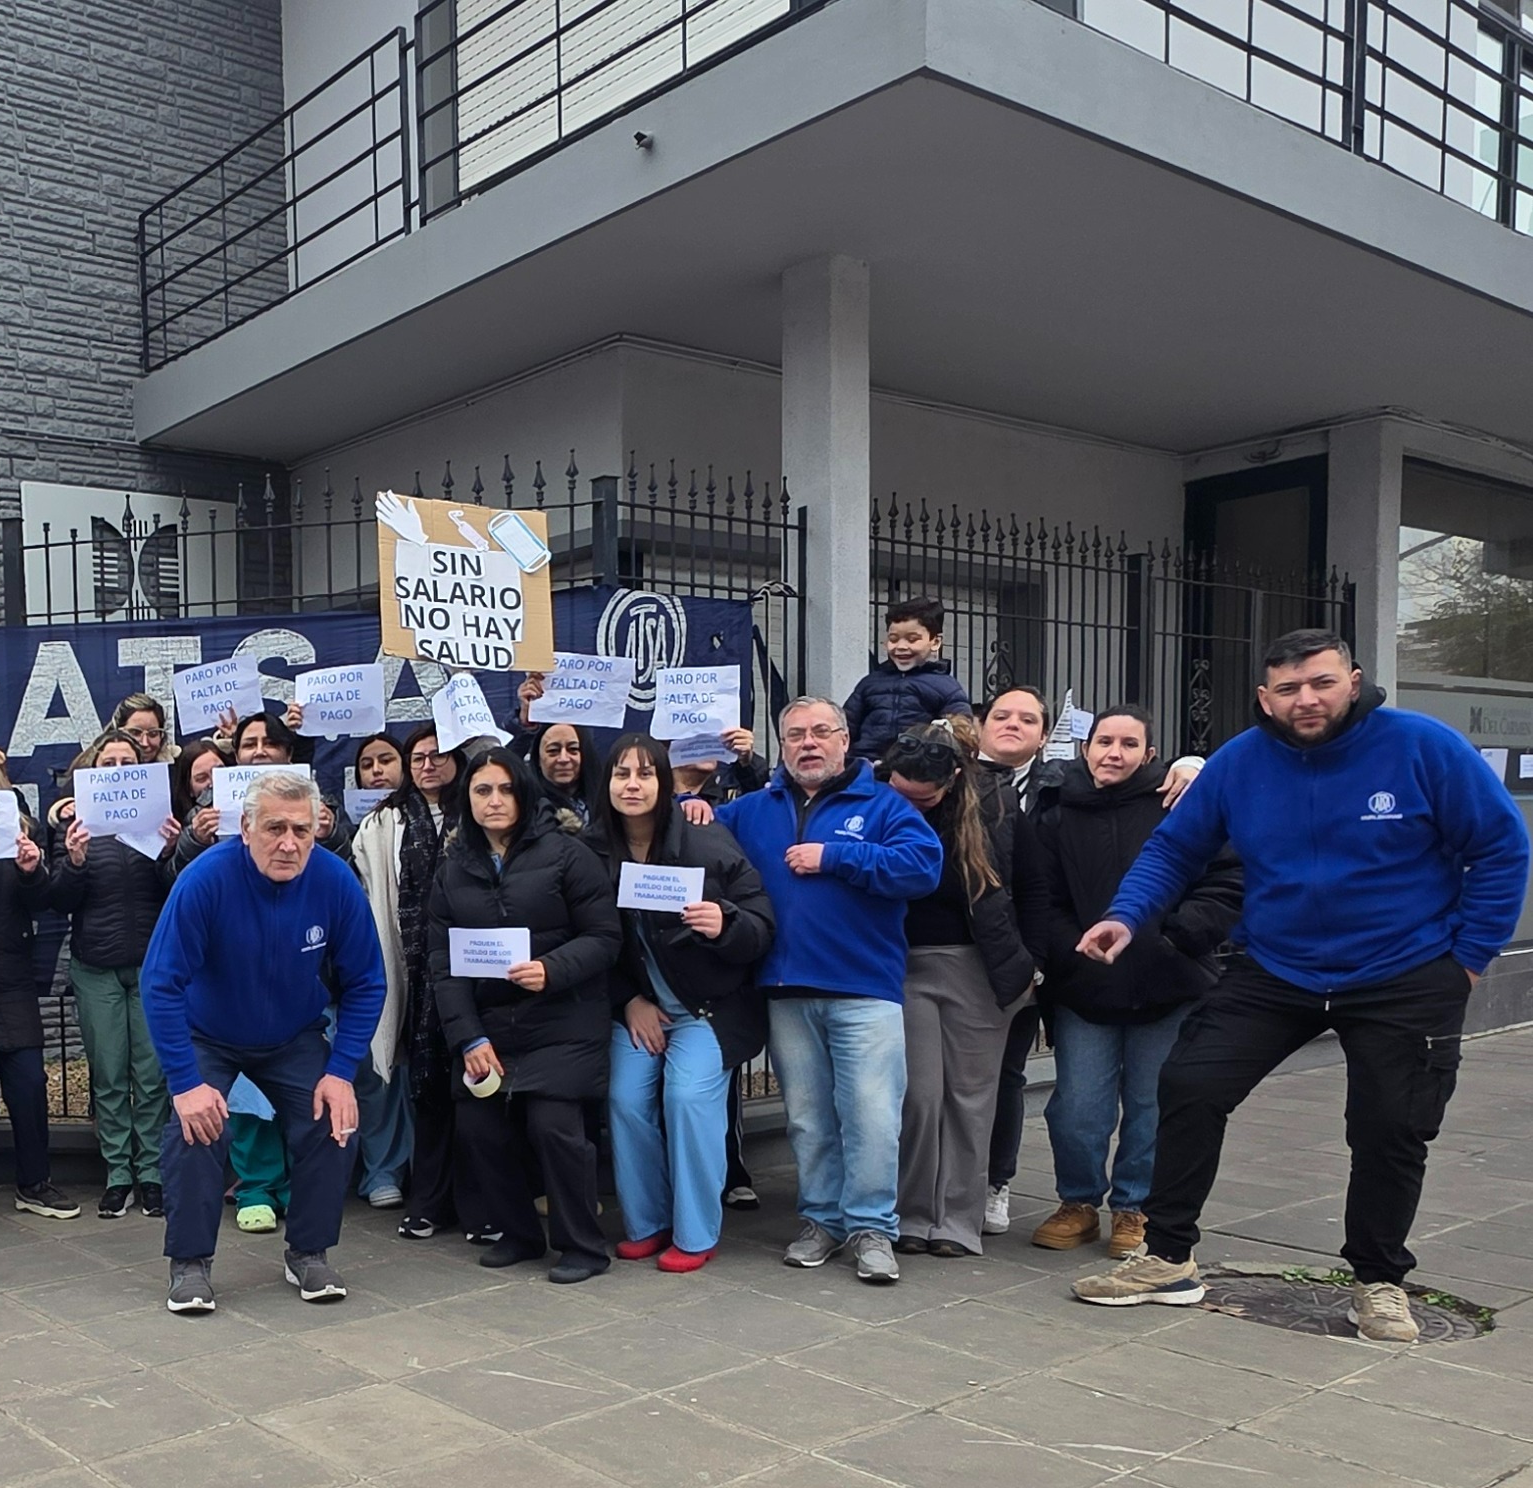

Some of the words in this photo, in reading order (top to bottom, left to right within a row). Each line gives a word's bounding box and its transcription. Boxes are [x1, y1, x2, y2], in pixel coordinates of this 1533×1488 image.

[433, 551, 481, 576] SIN
[395, 576, 521, 610] SALARIO
[405, 604, 449, 630] NO
[462, 614, 521, 640] HAY
[419, 639, 513, 668] SALUD
[587, 660, 613, 672] POR
[185, 668, 213, 684] PARO
[216, 662, 237, 676] POR
[307, 674, 336, 686] PARO
[340, 672, 363, 683] POR
[696, 673, 717, 684] POR
[191, 685, 222, 700] FALTA
[225, 680, 238, 692] DE
[550, 678, 587, 690] FALTA
[590, 680, 605, 691] DE
[310, 692, 343, 704] FALTA
[347, 690, 361, 701] DE
[702, 693, 716, 703] DE
[203, 700, 232, 715] PAGO
[559, 698, 593, 710] PAGO
[320, 709, 352, 720] PAGO
[459, 712, 491, 725] PAGO
[672, 712, 707, 724] PAGO
[90, 772, 120, 784] PARO
[124, 770, 148, 781] POR
[93, 790, 128, 803] FALTA
[132, 788, 146, 800] DE
[105, 808, 138, 820] PAGO
[643, 874, 671, 882] PAGUEN
[634, 892, 685, 902] TRABAJADORES
